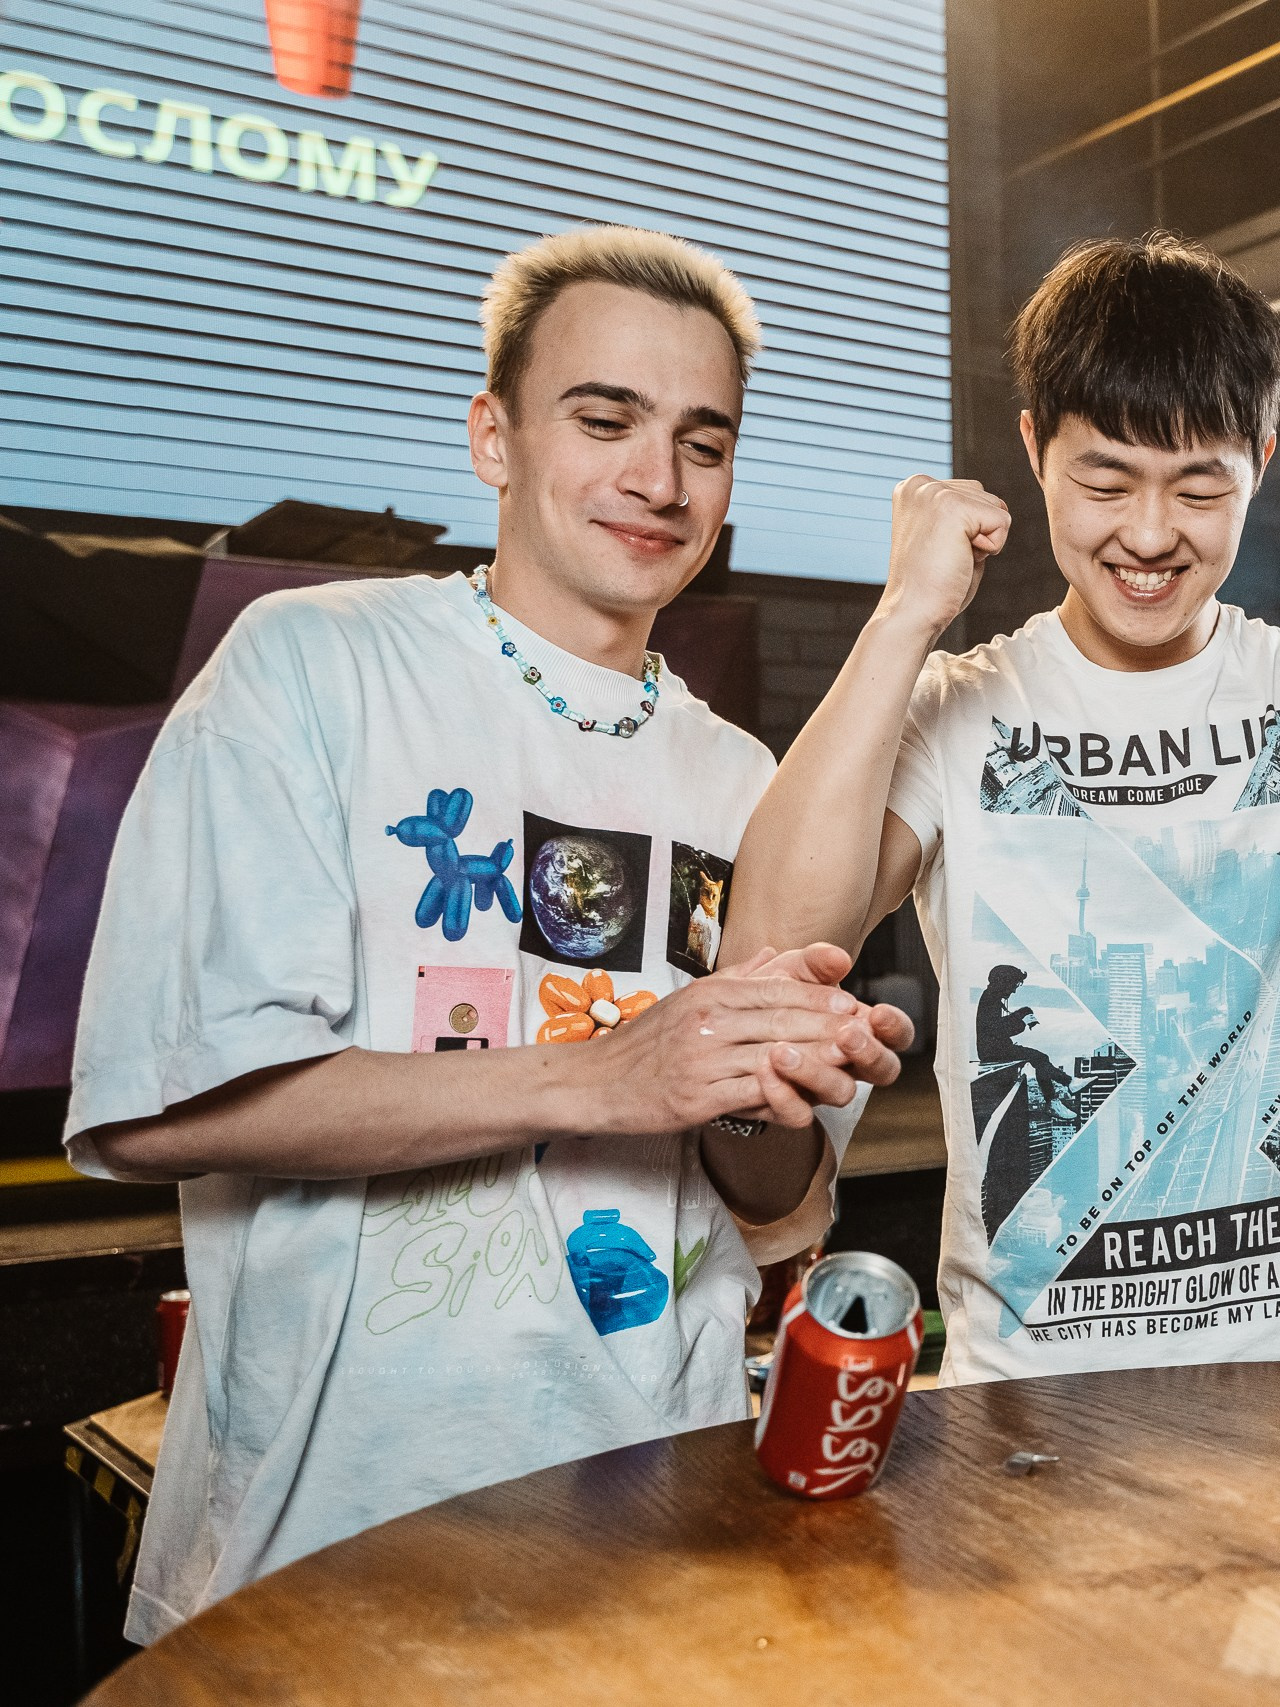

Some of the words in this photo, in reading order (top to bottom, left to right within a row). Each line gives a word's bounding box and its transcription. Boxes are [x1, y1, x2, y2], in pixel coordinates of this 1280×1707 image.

[1010, 721, 1191, 777] URBAN
[1072, 787, 1118, 803] DREAM
[1128, 788, 1164, 803] COME
[1170, 777, 1203, 798] TRUE
[1056, 1232, 1078, 1257] TO
[1079, 1206, 1101, 1231] BE
[1101, 1176, 1124, 1202] ON
[1123, 1138, 1152, 1173] TOP
[1156, 1111, 1176, 1135] OF
[1178, 1072, 1208, 1108] THE
[1208, 1010, 1253, 1069] WORLD
[1104, 1217, 1216, 1270] REACH
[1048, 1286, 1066, 1316] IN
[1071, 1281, 1106, 1312] THE
[1111, 1277, 1182, 1309] BRIGHT
[1185, 1267, 1234, 1302] GLOW
[1239, 1264, 1262, 1293] OF
[1267, 1264, 1278, 1290] A
[1031, 1328, 1053, 1342] HE
[1057, 1322, 1092, 1340] CITY
[1101, 1319, 1137, 1338] HAS
[1146, 1312, 1219, 1335] BECOME
[1227, 1306, 1255, 1325] MY
